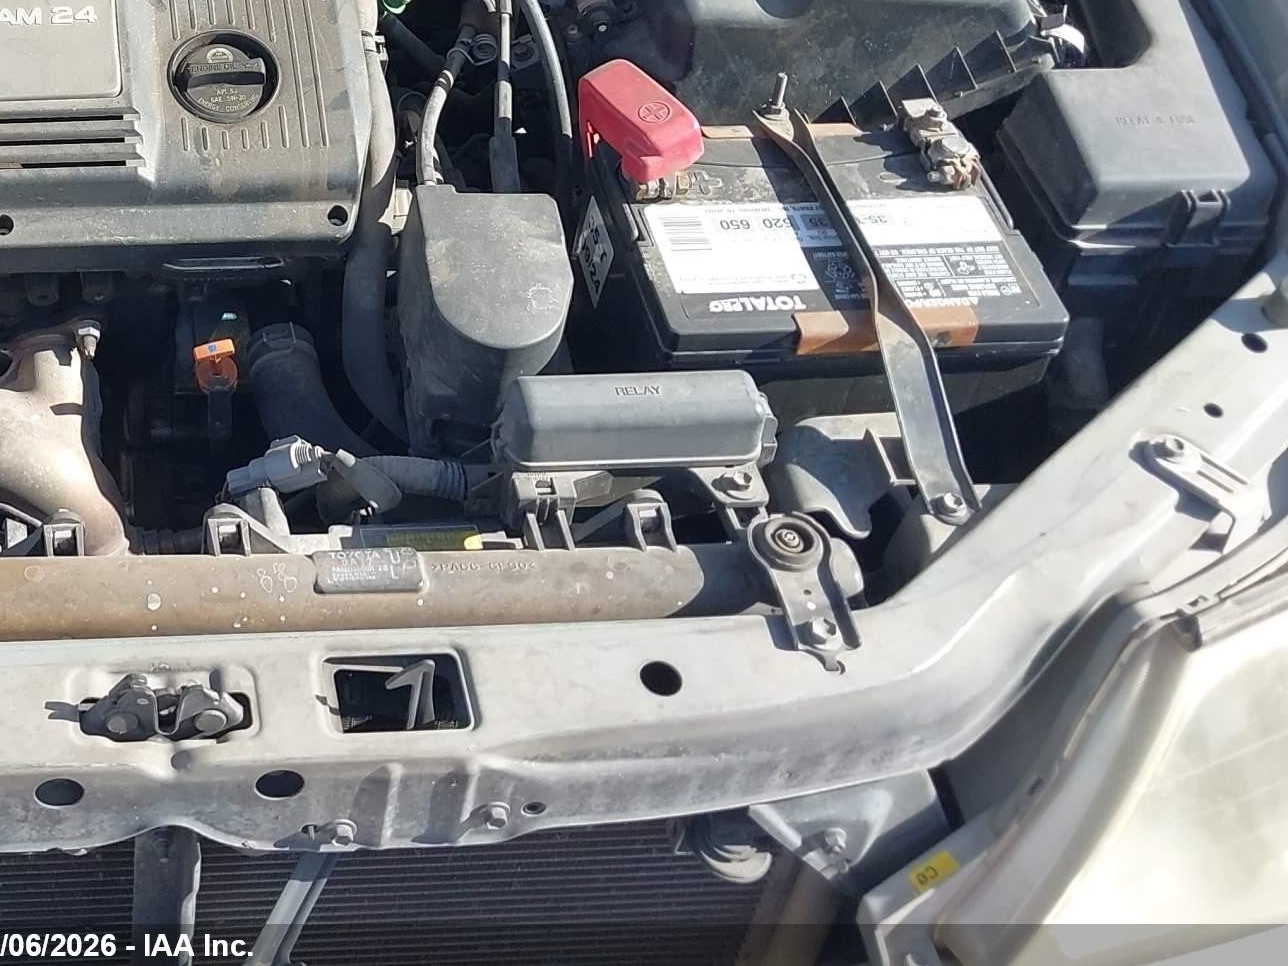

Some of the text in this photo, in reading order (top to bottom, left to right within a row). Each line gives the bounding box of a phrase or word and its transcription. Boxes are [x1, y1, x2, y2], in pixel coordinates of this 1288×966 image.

[50, 5, 97, 24] 24
[720, 219, 751, 230] 650
[614, 385, 660, 396] RELAY
